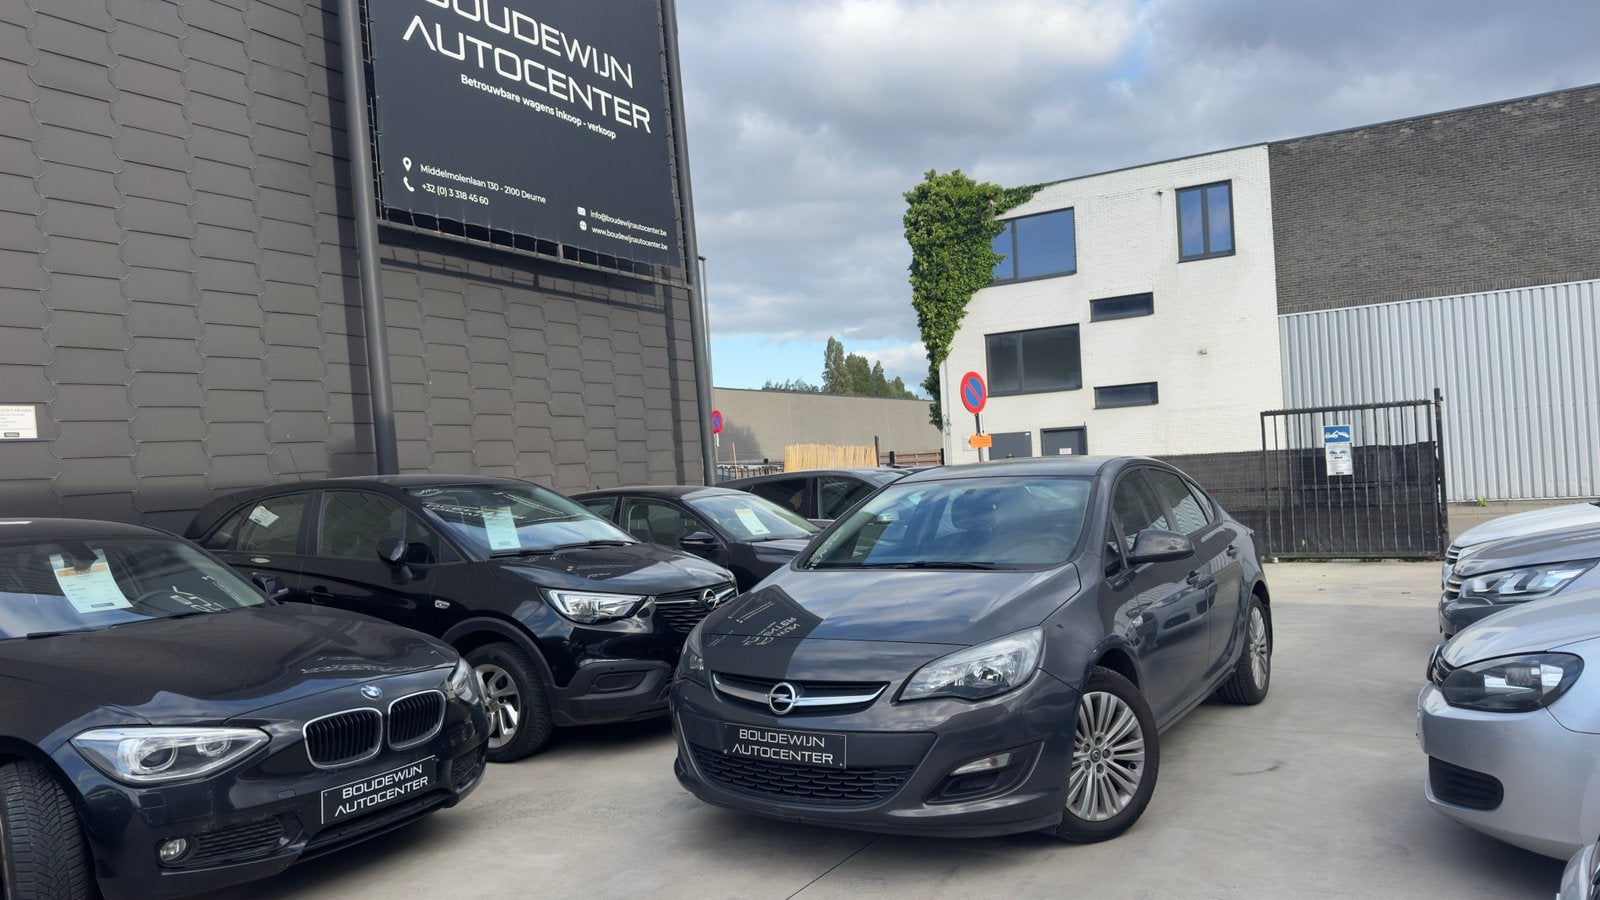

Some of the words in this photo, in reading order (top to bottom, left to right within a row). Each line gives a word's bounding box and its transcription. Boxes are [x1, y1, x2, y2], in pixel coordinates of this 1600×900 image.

[425, 0, 633, 89] OUDEWIJN
[402, 15, 651, 134] AUTOCENTER
[460, 73, 521, 103] Betrouwbare
[522, 96, 555, 116] wagens
[555, 107, 582, 127] inkoop
[587, 122, 617, 140] verkoop
[420, 164, 486, 188] Middelmolenlaan
[487, 180, 499, 191] 130
[504, 185, 520, 197] 2100
[521, 190, 546, 204] Deurne
[422, 183, 436, 194] +32
[437, 185, 448, 197] (0)
[448, 188, 454, 197] 3
[455, 190, 467, 200] 318
[468, 194, 479, 203] 45
[479, 196, 489, 205] 60
[590, 210, 667, 237] info@boudewijnautocenter.be
[591, 226, 668, 251] www.boudewijnautocenter.be
[732, 743, 834, 765] AUTOCENTER
[739, 728, 825, 748] BOUDEWIJN
[334, 776, 429, 817] AUTOCENTER
[342, 764, 422, 799] BOUDEWIJN
